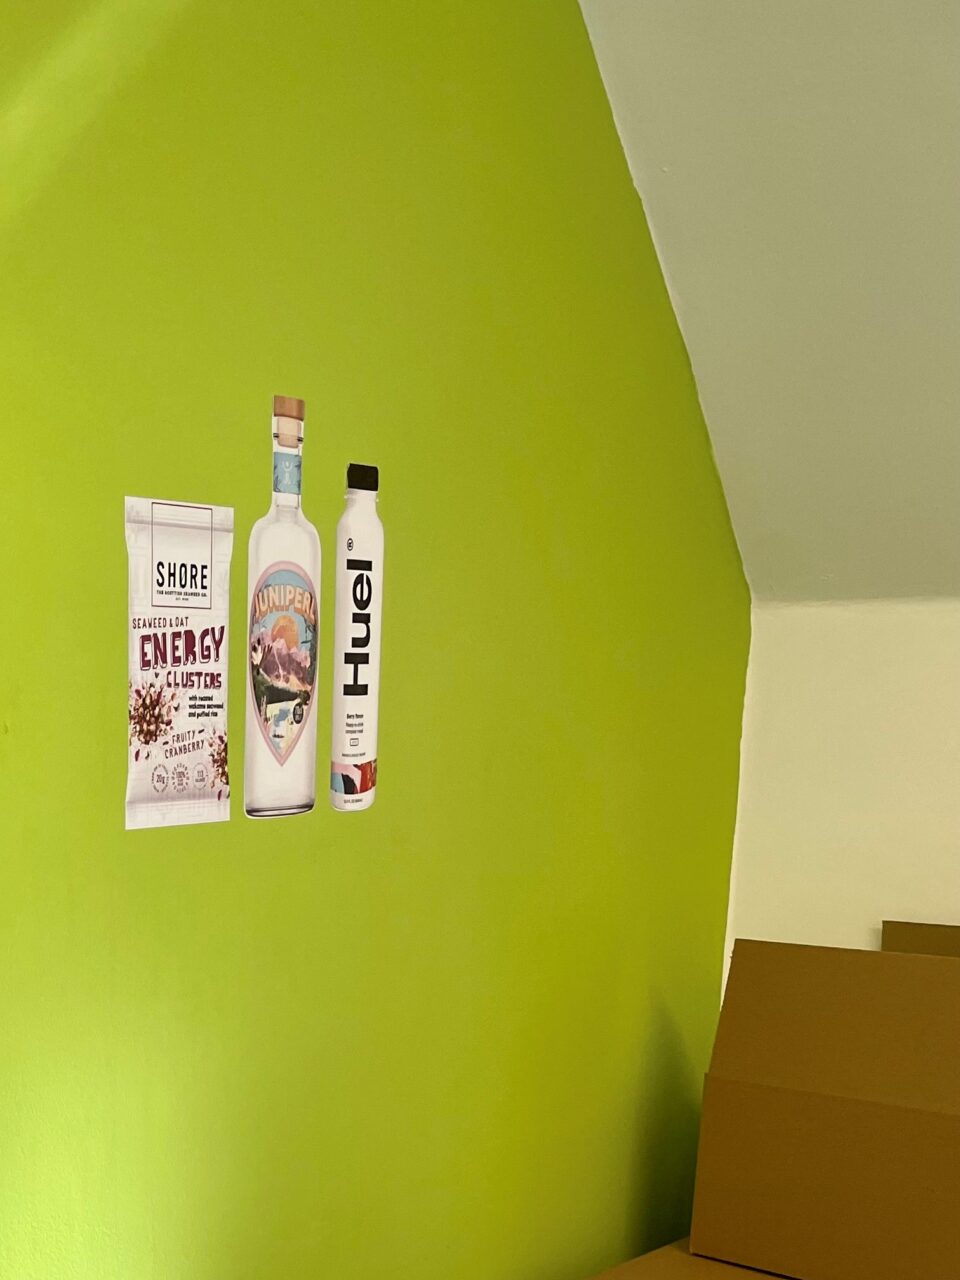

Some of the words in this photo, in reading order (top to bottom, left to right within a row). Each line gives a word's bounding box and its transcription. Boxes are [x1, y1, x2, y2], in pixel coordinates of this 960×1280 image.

[132, 618, 167, 629] SEAWEED
[175, 616, 189, 627] OAT
[343, 558, 373, 696] Huel
[139, 625, 225, 671] ENERGY
[166, 671, 222, 689] CLUSTERS
[172, 729, 196, 744] FRUITY
[164, 739, 205, 759] CRANBERRY
